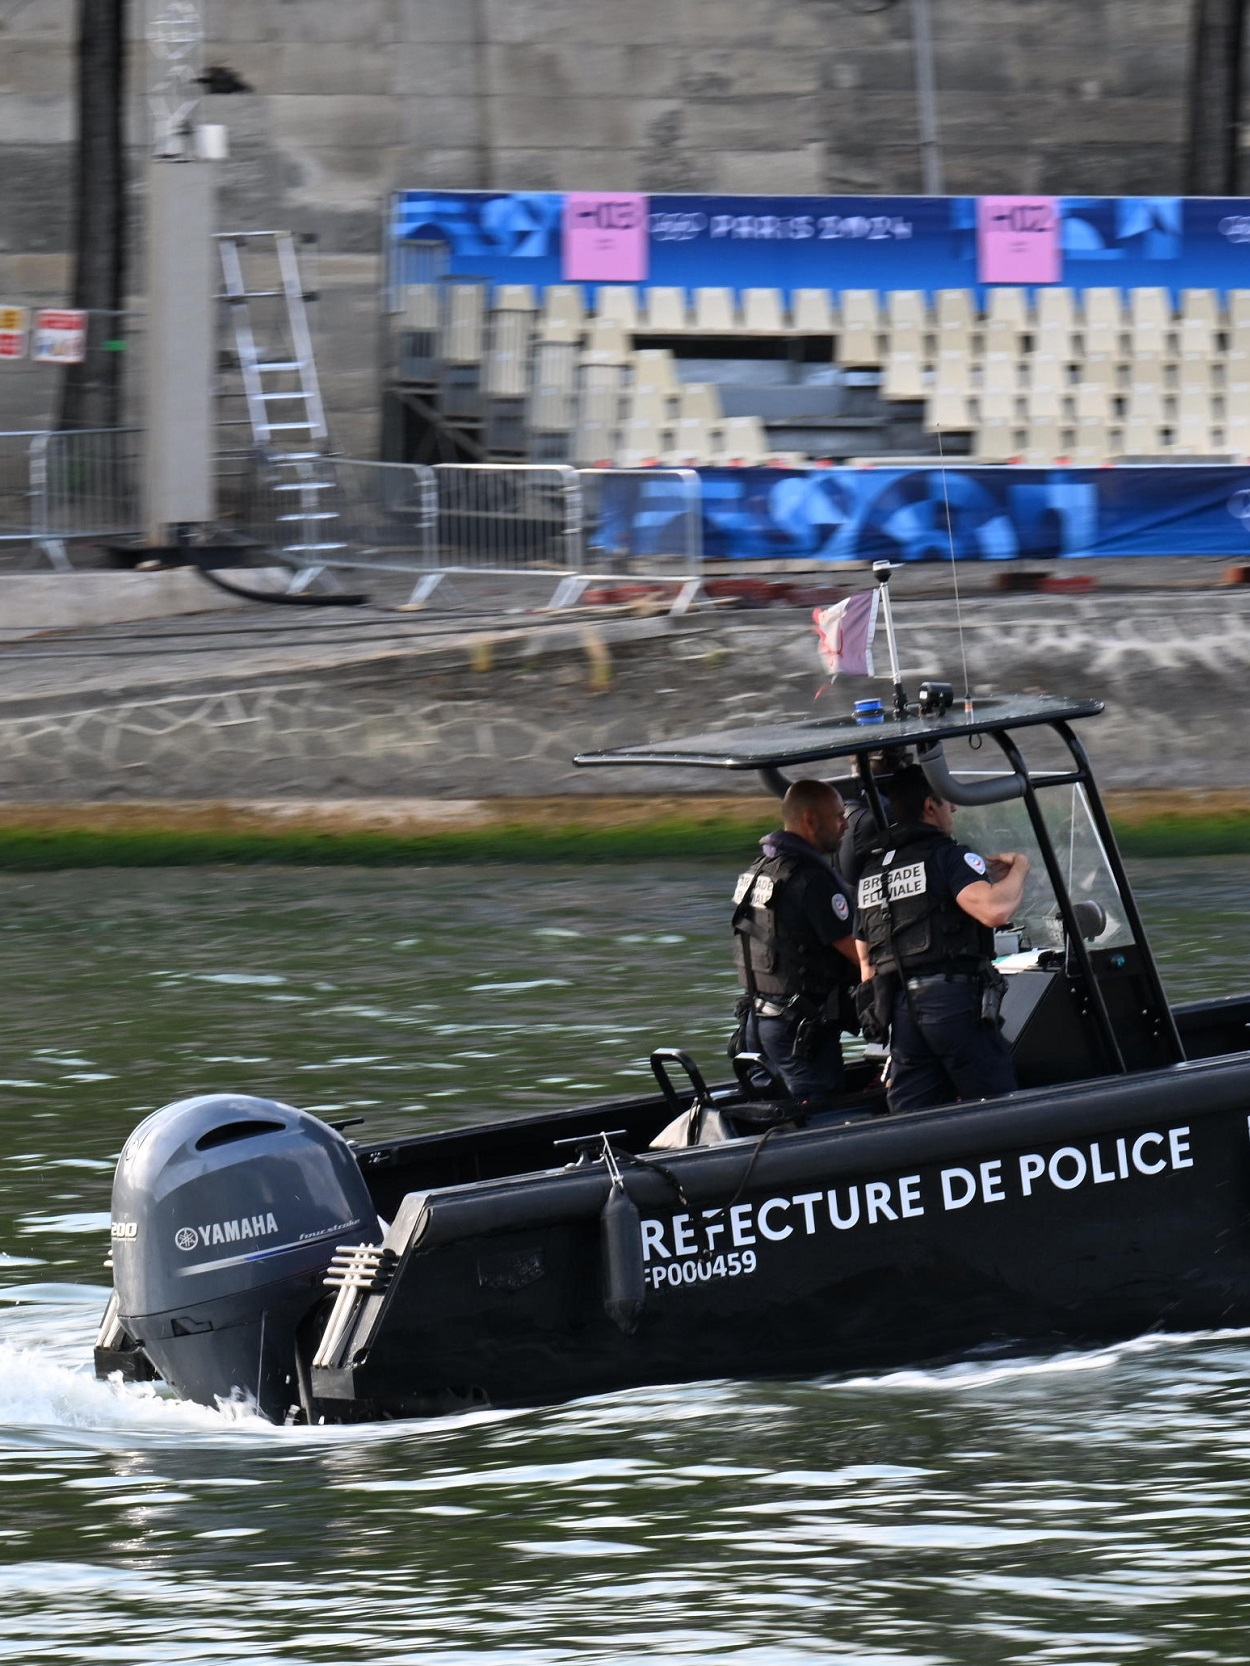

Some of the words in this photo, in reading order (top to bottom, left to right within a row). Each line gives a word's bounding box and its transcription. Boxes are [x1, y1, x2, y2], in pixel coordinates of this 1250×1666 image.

[817, 215, 912, 240] 2024
[863, 866, 922, 890] BRGADE
[640, 1174, 925, 1262] REFECTURE
[941, 1160, 1006, 1210] DE
[1019, 1127, 1194, 1196] POLICE
[111, 1222, 138, 1238] 200
[197, 1213, 279, 1247] YAMAHA
